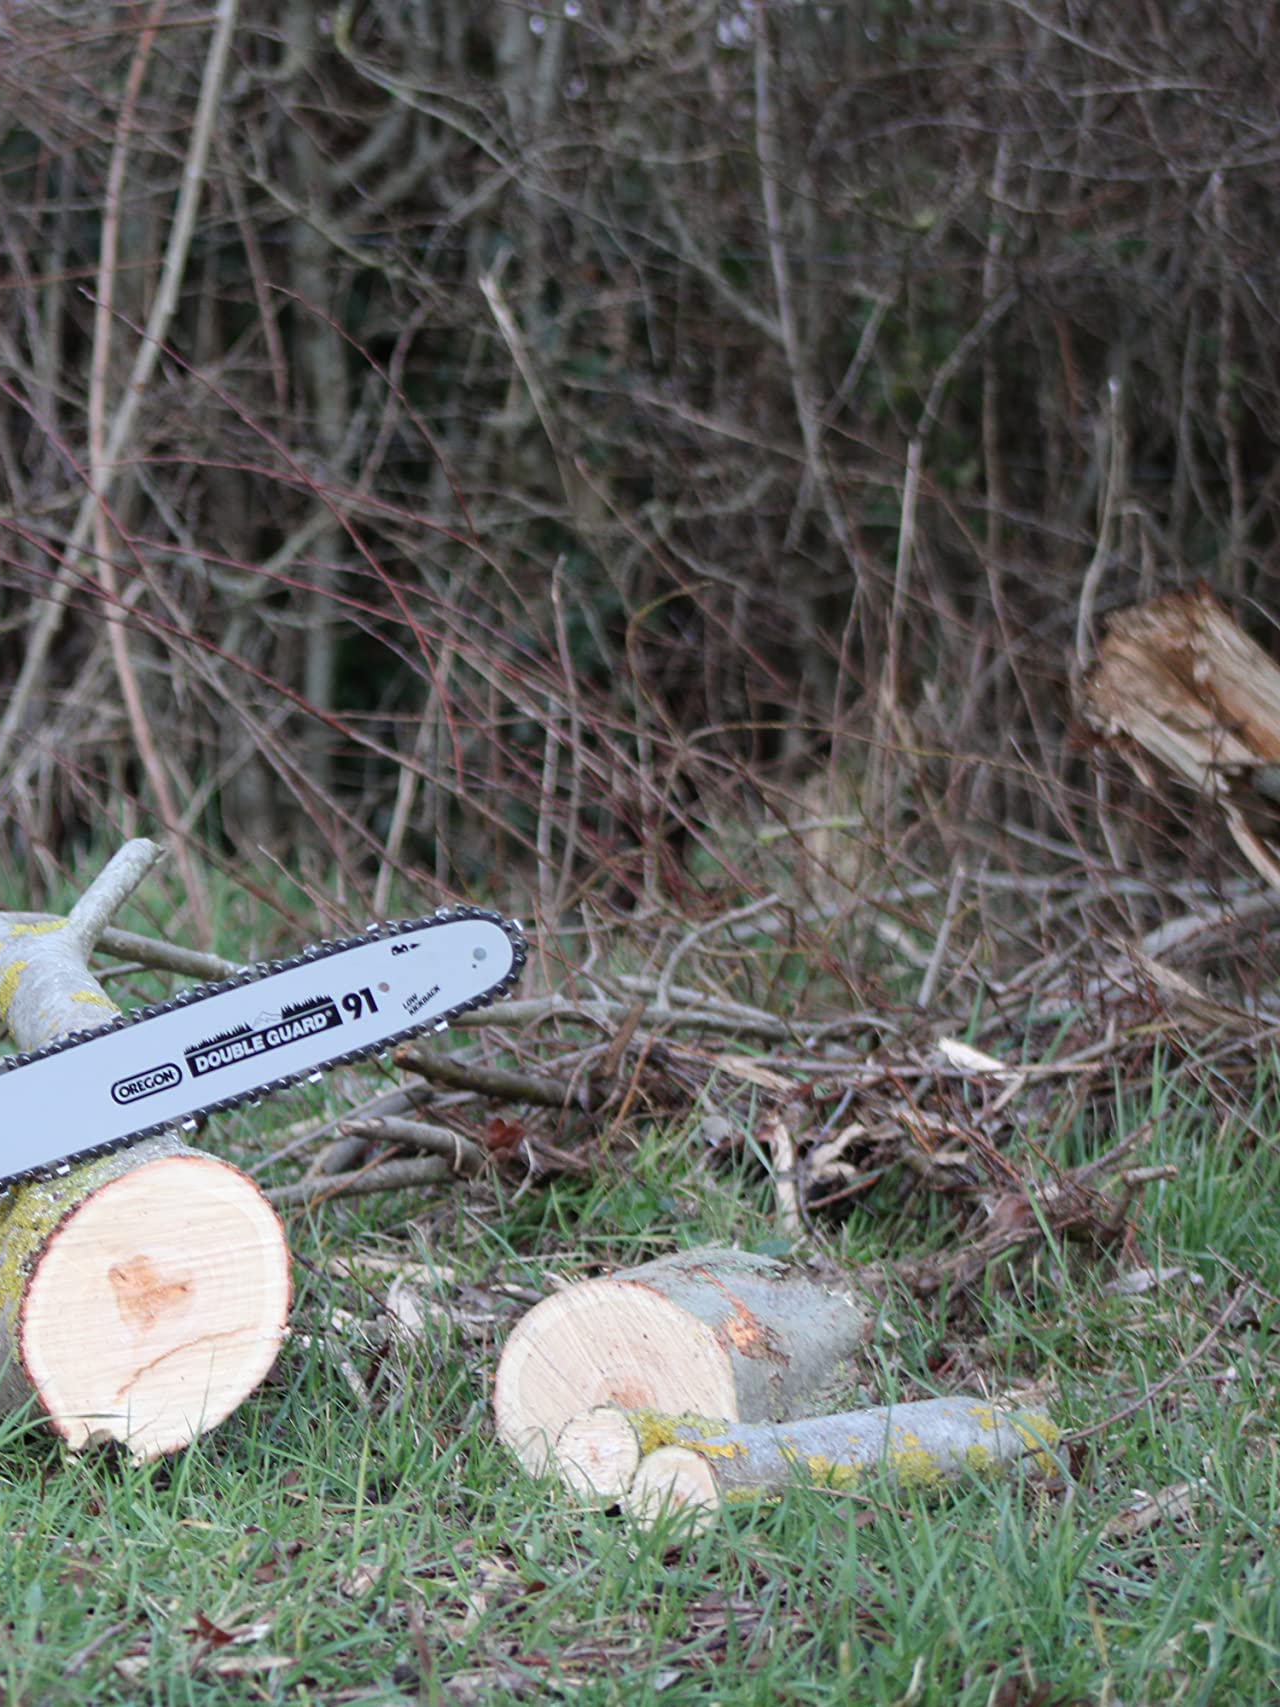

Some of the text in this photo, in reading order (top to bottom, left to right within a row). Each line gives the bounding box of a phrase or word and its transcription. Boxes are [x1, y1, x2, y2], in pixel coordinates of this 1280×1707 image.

[402, 993, 418, 1010] LOW
[195, 987, 378, 1073] DOUBLE GUARD 91
[118, 1070, 175, 1099] OREGON
